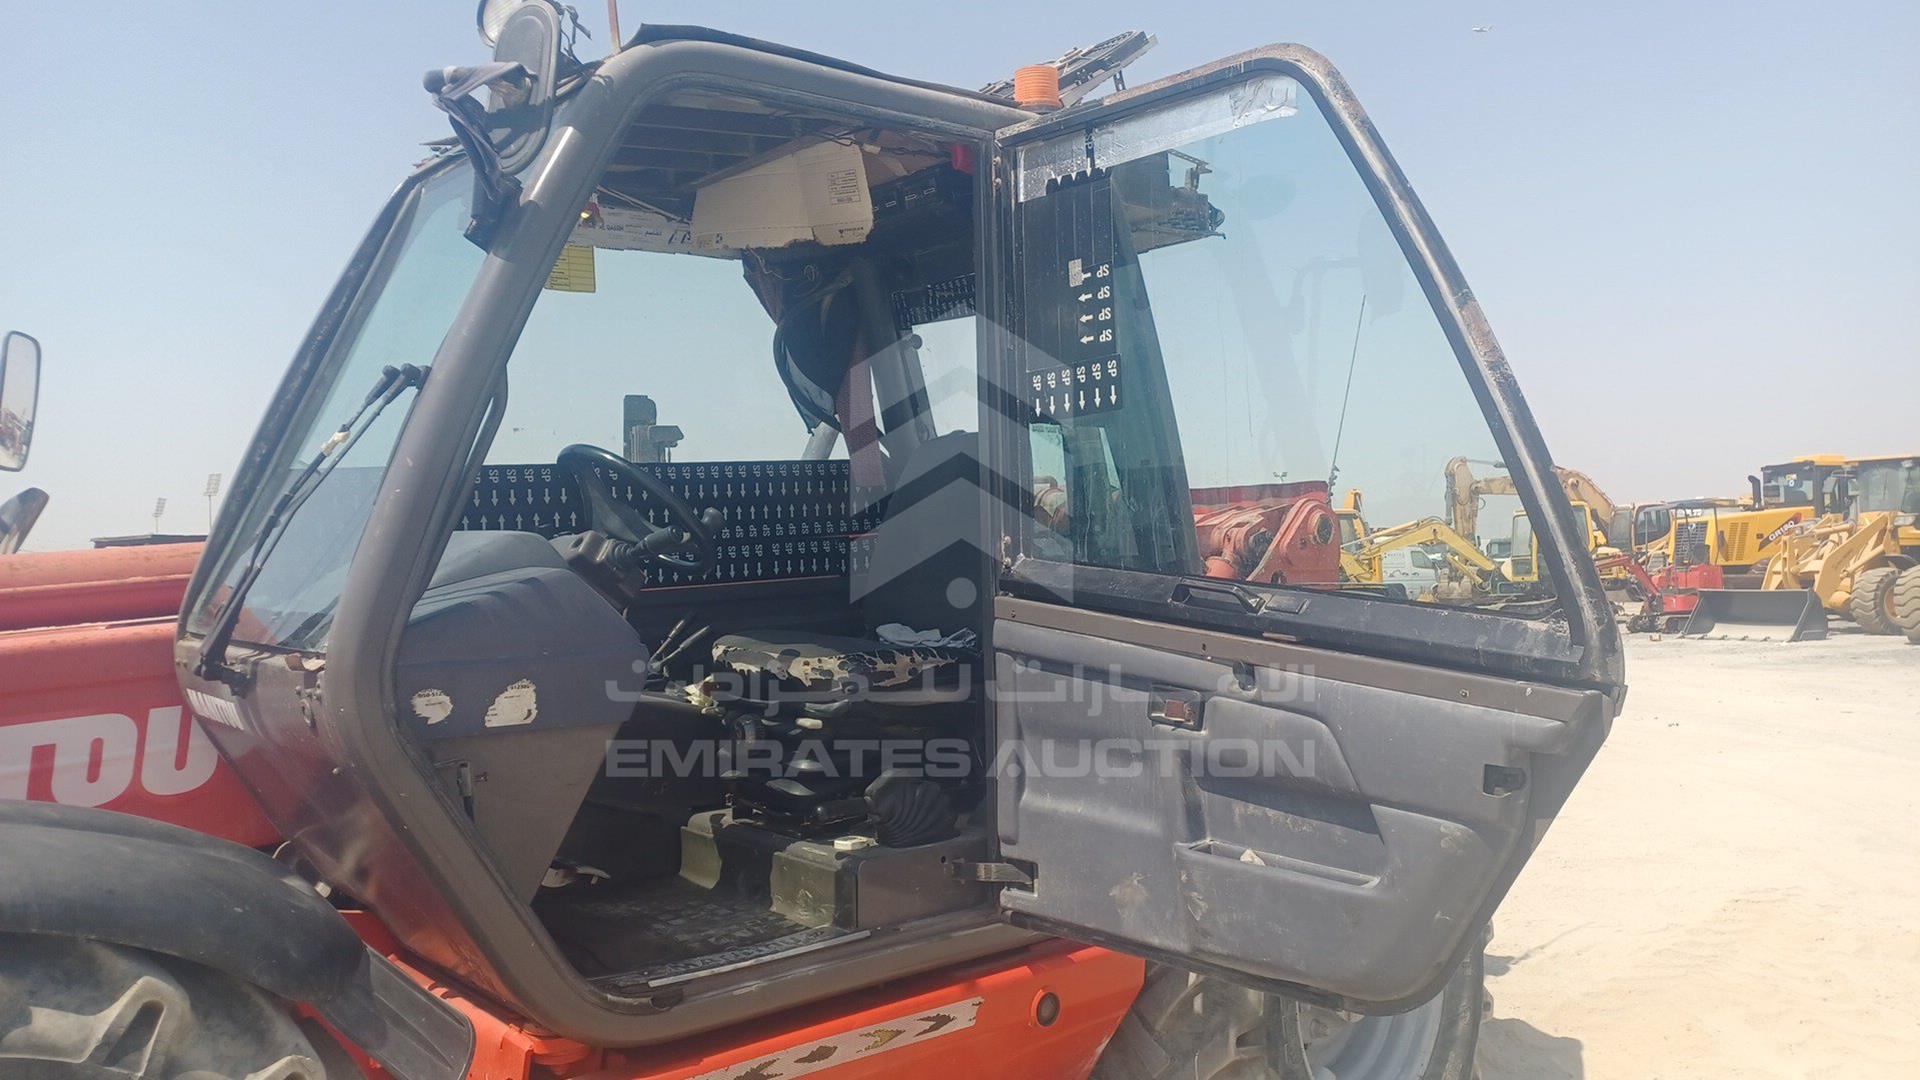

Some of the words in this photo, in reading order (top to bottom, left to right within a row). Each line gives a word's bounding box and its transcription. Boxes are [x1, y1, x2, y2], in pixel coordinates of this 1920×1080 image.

[1097, 264, 1110, 278] SP
[1097, 286, 1110, 299] SP
[1098, 307, 1112, 321] SP
[1099, 329, 1113, 343] SP
[1077, 366, 1086, 383] SP
[1092, 363, 1101, 380] SP
[1107, 359, 1117, 377] SP
[1033, 375, 1042, 391] SP
[1047, 372, 1056, 389] SP
[1062, 369, 1071, 386] SP
[489, 469, 500, 484] SP
[506, 469, 517, 483] SP
[524, 468, 534, 483] SP
[541, 468, 551, 482] SP
[667, 466, 677, 480] SP
[682, 466, 691, 479] SP
[696, 466, 705, 479] SP
[711, 465, 720, 479] SP
